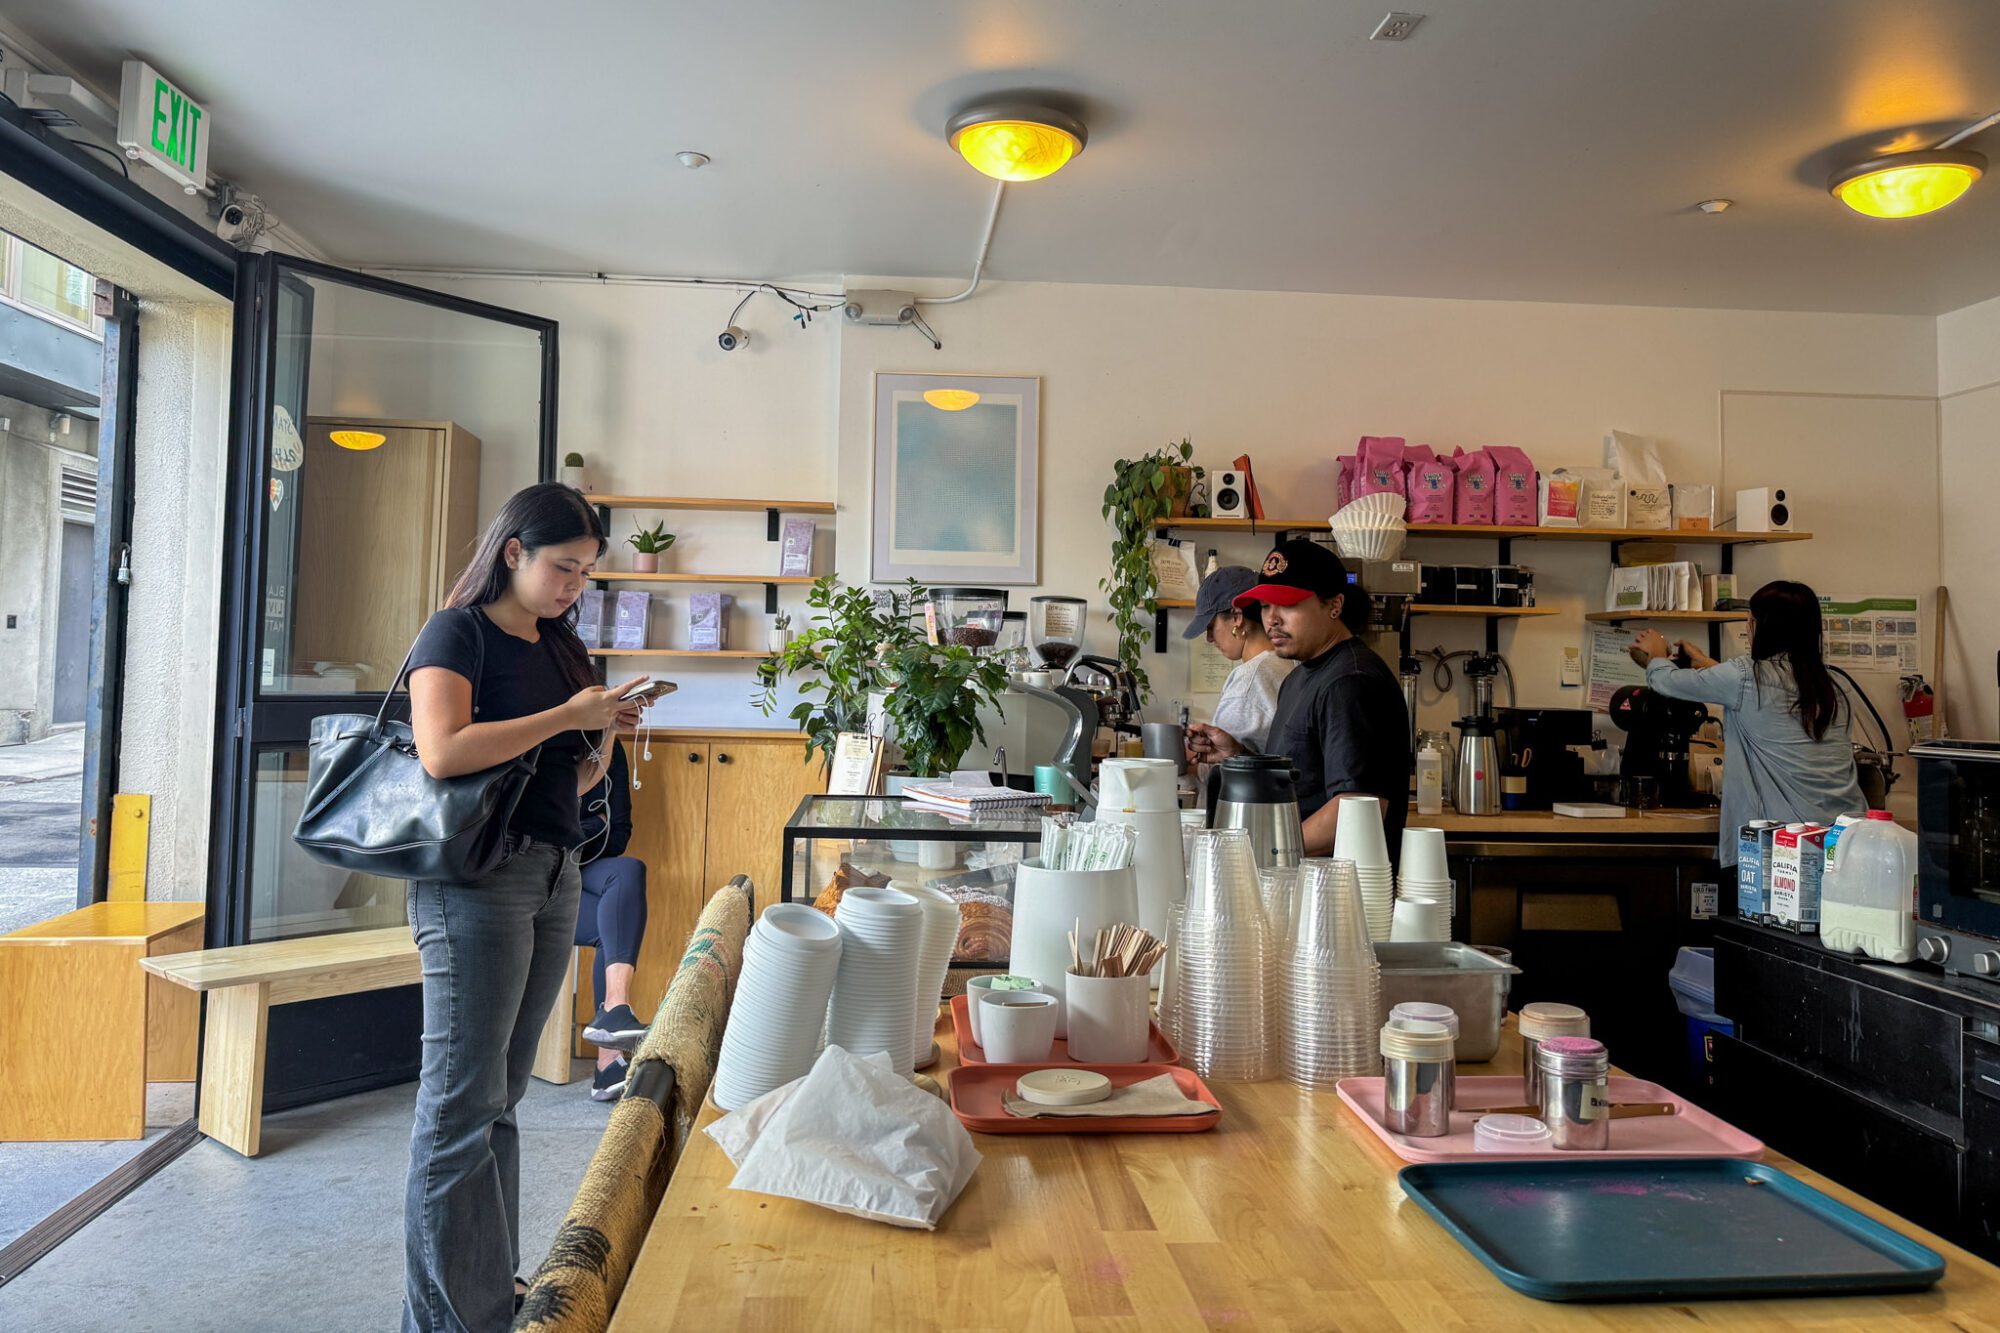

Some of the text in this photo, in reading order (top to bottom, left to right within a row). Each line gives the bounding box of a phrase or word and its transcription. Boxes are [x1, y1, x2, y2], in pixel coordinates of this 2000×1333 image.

[151, 78, 201, 173] EXIT
[1738, 856, 1760, 867] CALIFIA
[1772, 861, 1798, 874] CALIFIA
[1741, 869, 1756, 884] OAT
[1773, 875, 1796, 892] ALMOND
